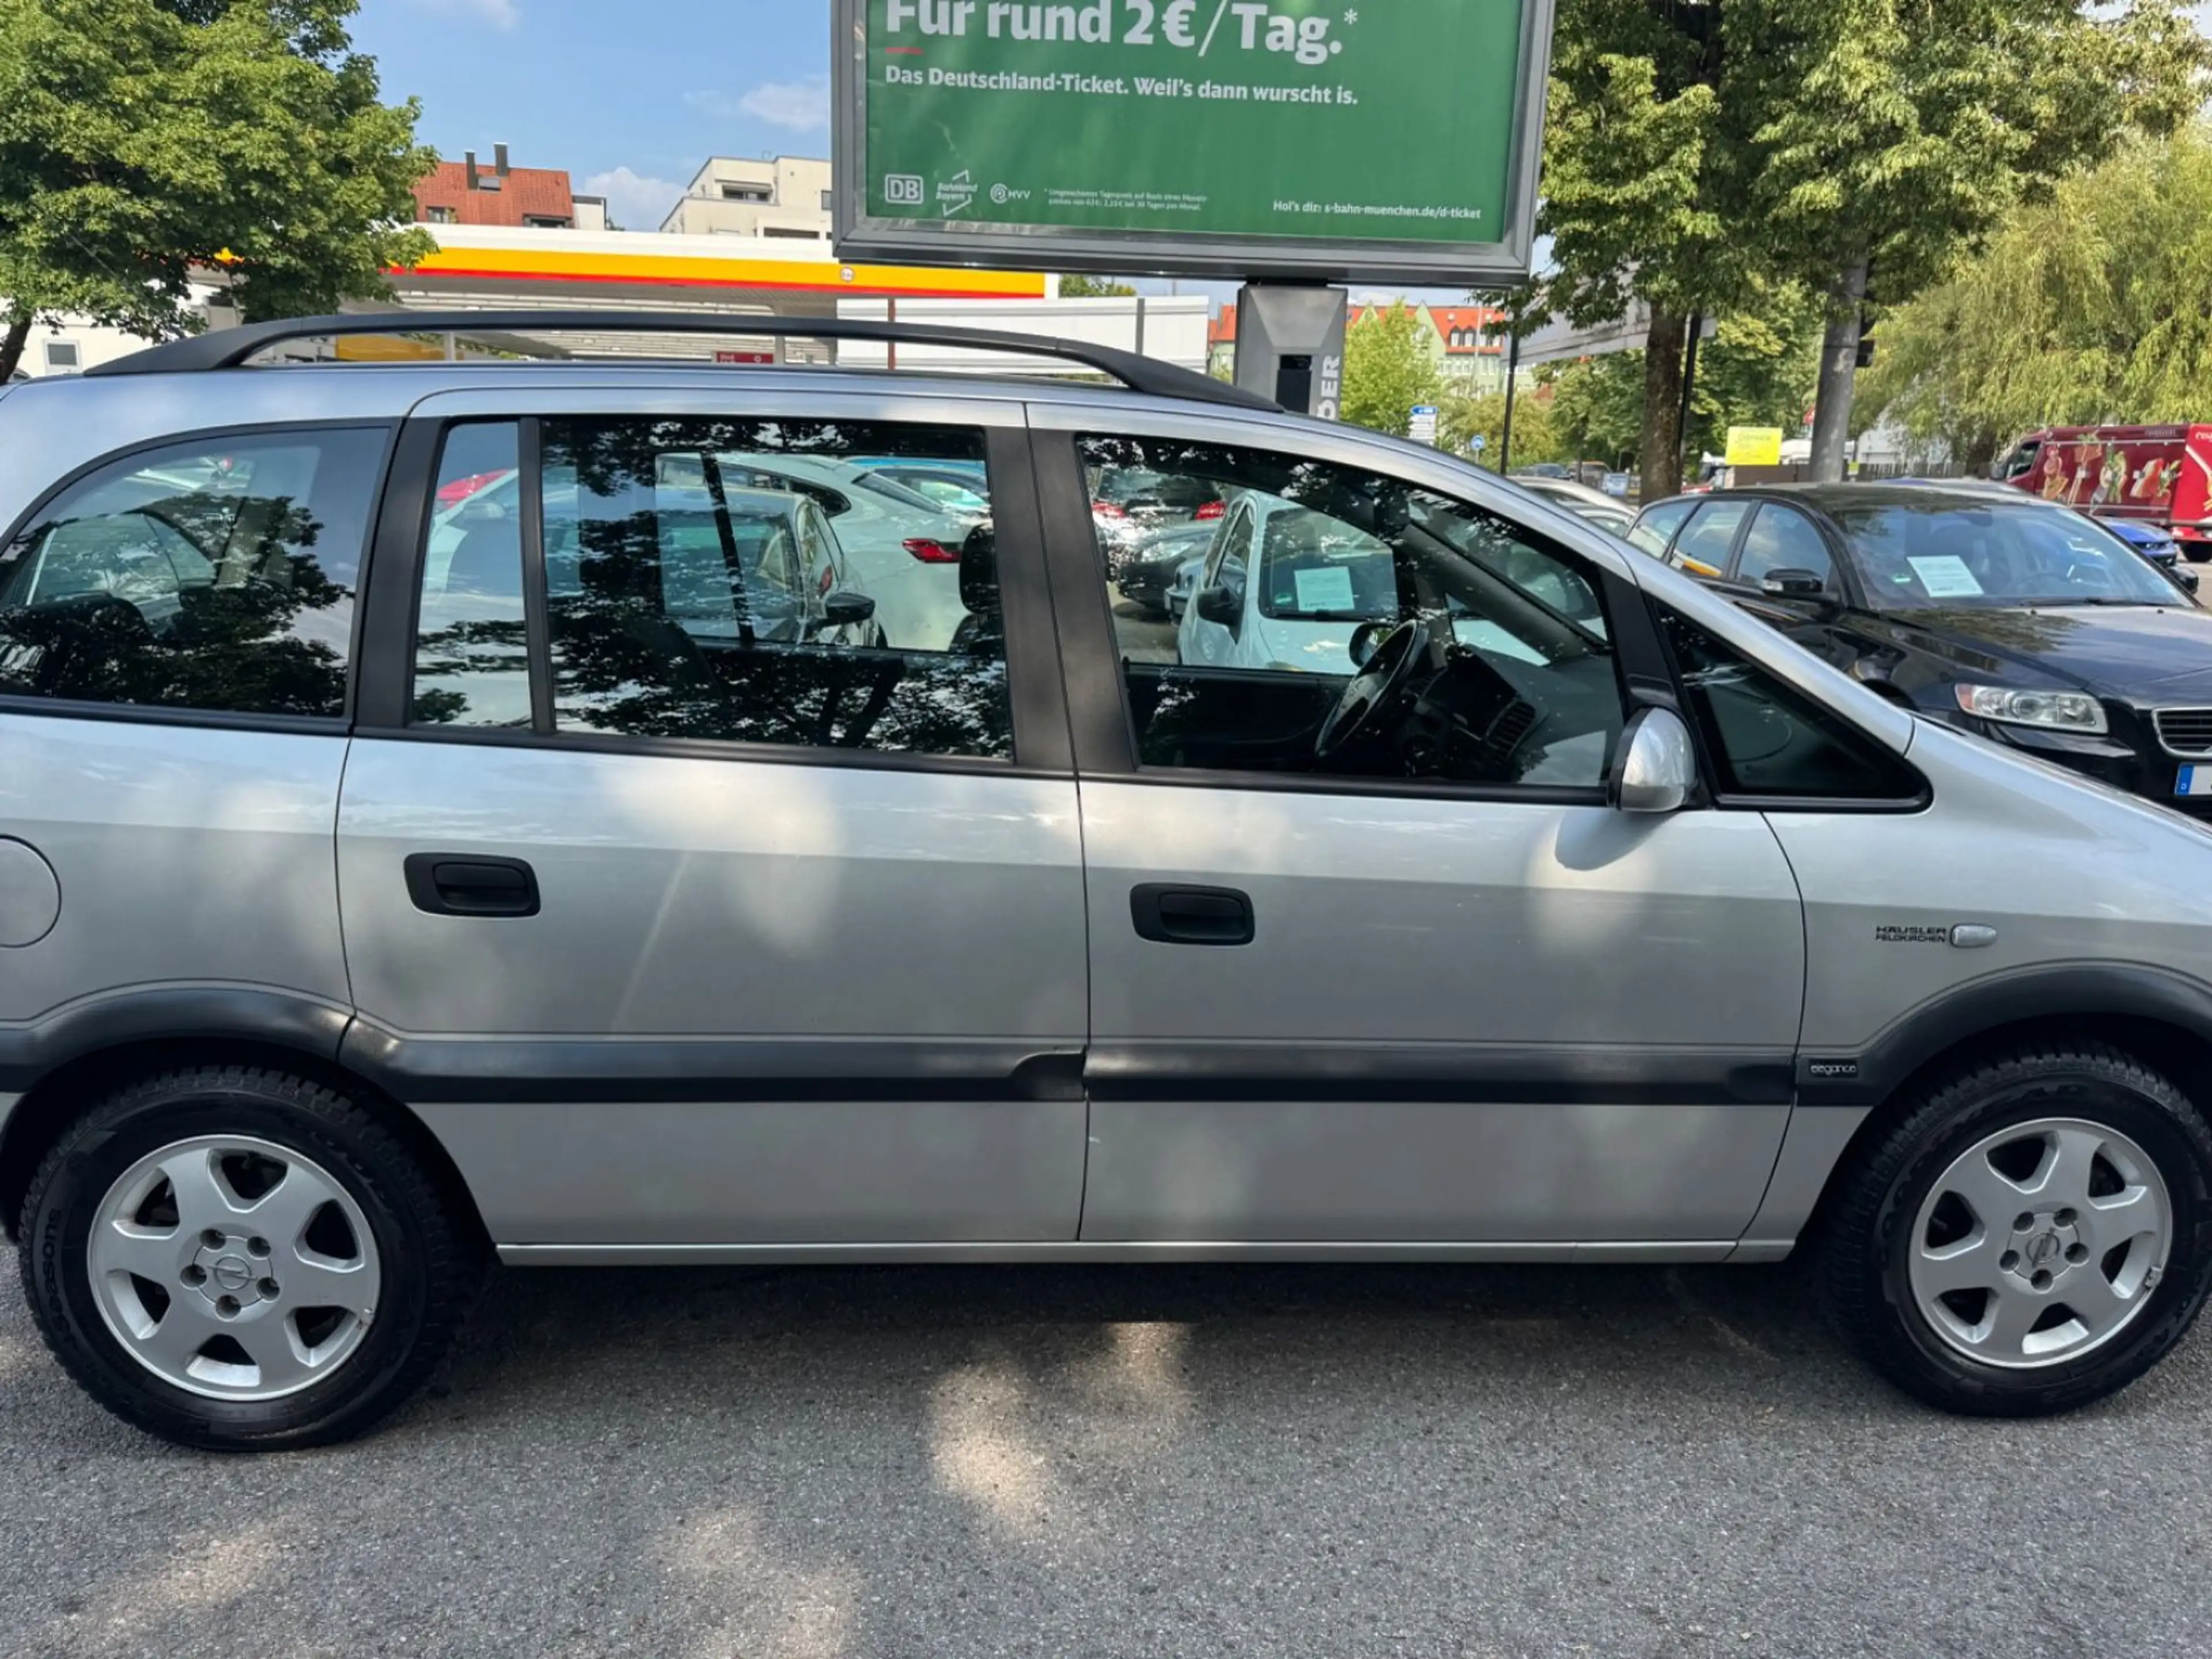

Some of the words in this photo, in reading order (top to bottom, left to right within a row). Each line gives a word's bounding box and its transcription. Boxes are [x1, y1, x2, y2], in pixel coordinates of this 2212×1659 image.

[987, 0, 1111, 43] rund
[885, 65, 923, 85] Das
[929, 67, 1128, 94] Deutschland-Ticket.
[1198, 80, 1248, 101] dann
[1253, 84, 1332, 104] wurscht
[1336, 86, 1358, 105] is.
[890, 180, 919, 199] DB
[1273, 200, 1299, 211] Hol's
[1324, 204, 1482, 221] s-bahn-muenchen.de/d-ticket
